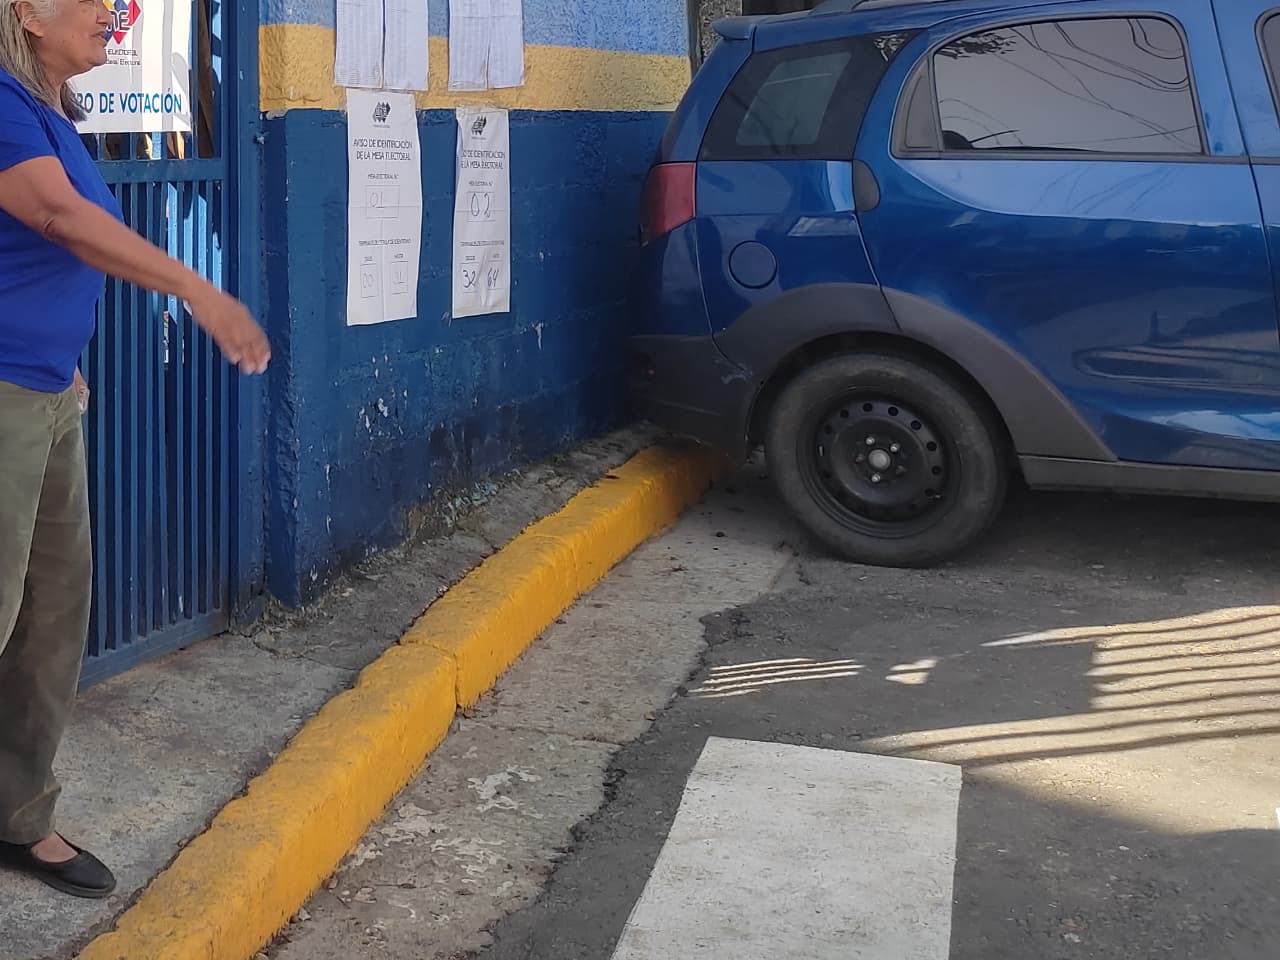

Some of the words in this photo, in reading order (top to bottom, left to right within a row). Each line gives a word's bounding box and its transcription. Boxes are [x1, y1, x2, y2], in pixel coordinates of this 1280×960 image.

[106, 9, 131, 32] NE
[100, 92, 114, 113] DE
[119, 87, 182, 114] VOTACIÓN
[471, 192, 491, 218] 02
[462, 269, 477, 289] 32
[488, 267, 500, 288] 64
